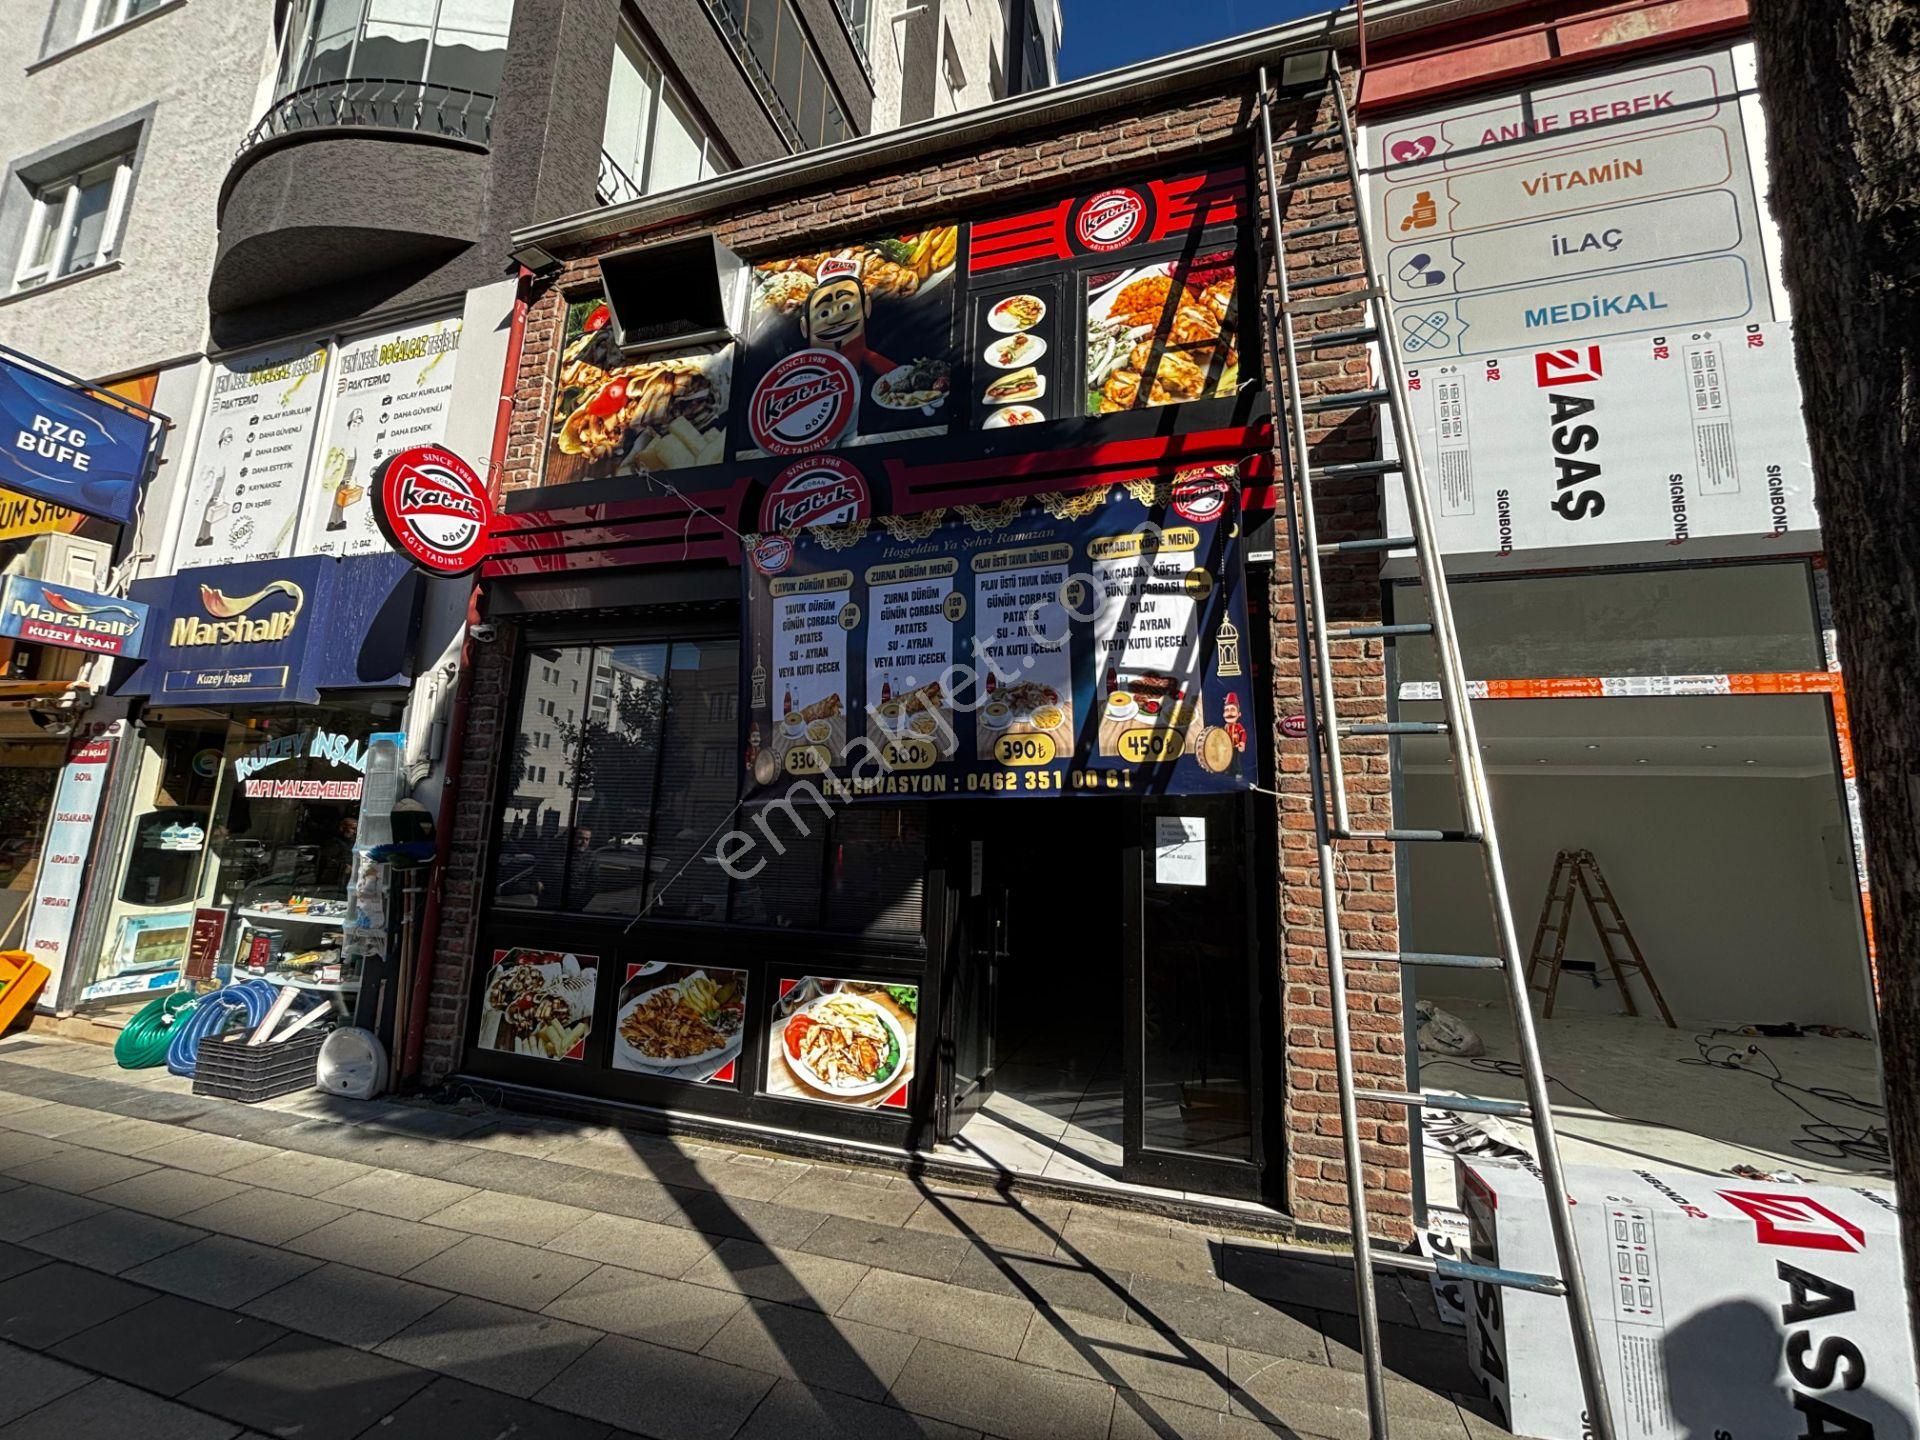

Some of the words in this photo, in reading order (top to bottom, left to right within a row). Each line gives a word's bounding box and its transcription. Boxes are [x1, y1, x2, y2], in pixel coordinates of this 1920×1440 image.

[1480, 114, 1558, 146] ANNE
[1570, 90, 1674, 128] BEBEK
[1522, 158, 1644, 197] VİTAMİN
[1552, 228, 1624, 257] İLAÇ
[1524, 290, 1668, 328] MEDİKAL
[32, 414, 86, 448] RZG
[16, 430, 91, 472] BÜFE
[1549, 394, 1606, 520] ASAŞ
[422, 453, 453, 468] SINCE
[455, 466, 473, 484] 1988
[786, 458, 818, 478] SINCE
[1669, 474, 1688, 540] SIGNBOND
[1767, 464, 1788, 532] SIGNBOND
[1497, 489, 1512, 552] SIGNBOND
[882, 540, 939, 559] Hoşgeldin
[943, 540, 958, 552] Ya
[962, 534, 992, 552] Şehri
[997, 528, 1056, 544] Ramazan
[1168, 530, 1194, 546] MENÜ
[426, 550, 464, 566] TADINIZ
[872, 570, 896, 582] ZURNA
[900, 564, 927, 578] DÜRÜM
[930, 560, 952, 574] MENÜ
[1154, 560, 1181, 576] KÖFTE
[774, 582, 796, 594] TAVUK
[798, 577, 824, 591] DÜRÜM
[826, 573, 848, 588] MENÜ
[1041, 571, 1063, 586] DÖNER
[884, 592, 909, 605] ZURNA
[911, 586, 940, 601] DÜRÜM
[1106, 582, 1137, 598] GÜNÜN
[785, 603, 806, 616] TAVUK
[808, 600, 836, 612] DÜRÜM
[987, 592, 1016, 608] GÜNÜN
[12, 601, 132, 636] Marshall
[880, 606, 907, 620] GÜNÜN
[170, 611, 292, 648] Marshall
[782, 618, 804, 632] GÜNÜN
[807, 615, 838, 629] ÇORBASI
[894, 622, 928, 635] PATATES
[997, 628, 1008, 638] SU
[1117, 622, 1128, 632] SU
[1140, 618, 1171, 632] AYRAN
[28, 626, 70, 642] KUZEY
[74, 631, 117, 650] İNŞAAT
[794, 632, 823, 646] PATATES
[888, 640, 898, 651] SU
[906, 638, 934, 650] AYRAN
[1102, 638, 1124, 652] VEYA
[1128, 637, 1152, 650] KUTU
[789, 650, 799, 662] SU
[806, 646, 828, 660] AYRAN
[1006, 644, 1028, 656] KUTU
[778, 666, 794, 678] VEYA
[797, 664, 814, 676] KUTU
[874, 657, 894, 668] VEYA
[896, 655, 916, 667] KUTU
[197, 674, 222, 688] Kuzey
[224, 672, 252, 686] İnşaat
[234, 732, 307, 782] KUZEY
[310, 726, 370, 774] İNŞAA
[74, 772, 92, 782] BOYA
[823, 774, 946, 796] REZERVASYON
[967, 772, 1017, 791] 0462
[1025, 770, 1062, 790] 351
[1072, 770, 1098, 788] 00
[1106, 768, 1132, 788] 61
[246, 779, 274, 798] YAPI
[274, 777, 364, 800] MALZEMELERİ
